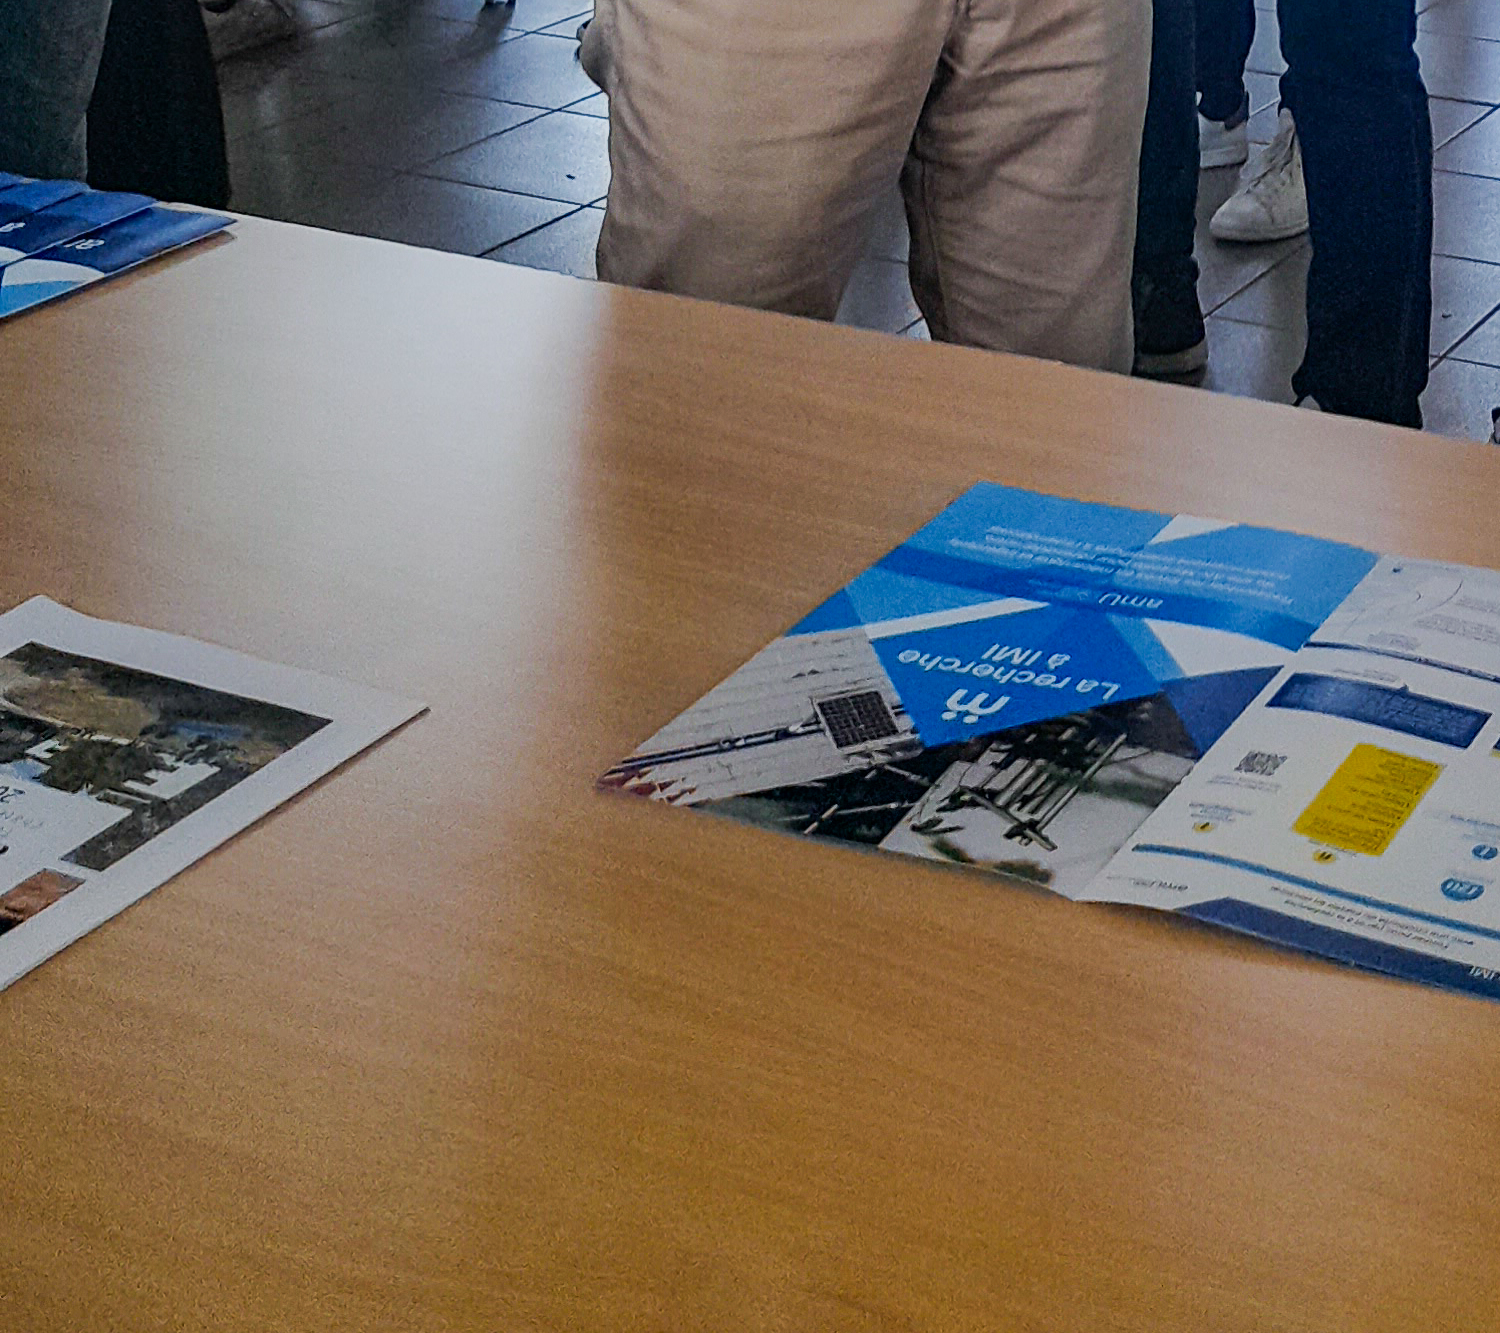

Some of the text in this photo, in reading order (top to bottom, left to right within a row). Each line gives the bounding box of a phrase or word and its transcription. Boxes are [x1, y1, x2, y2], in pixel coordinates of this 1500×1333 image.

[981, 643, 1043, 666] IMI
[897, 649, 1122, 701] La recherche
